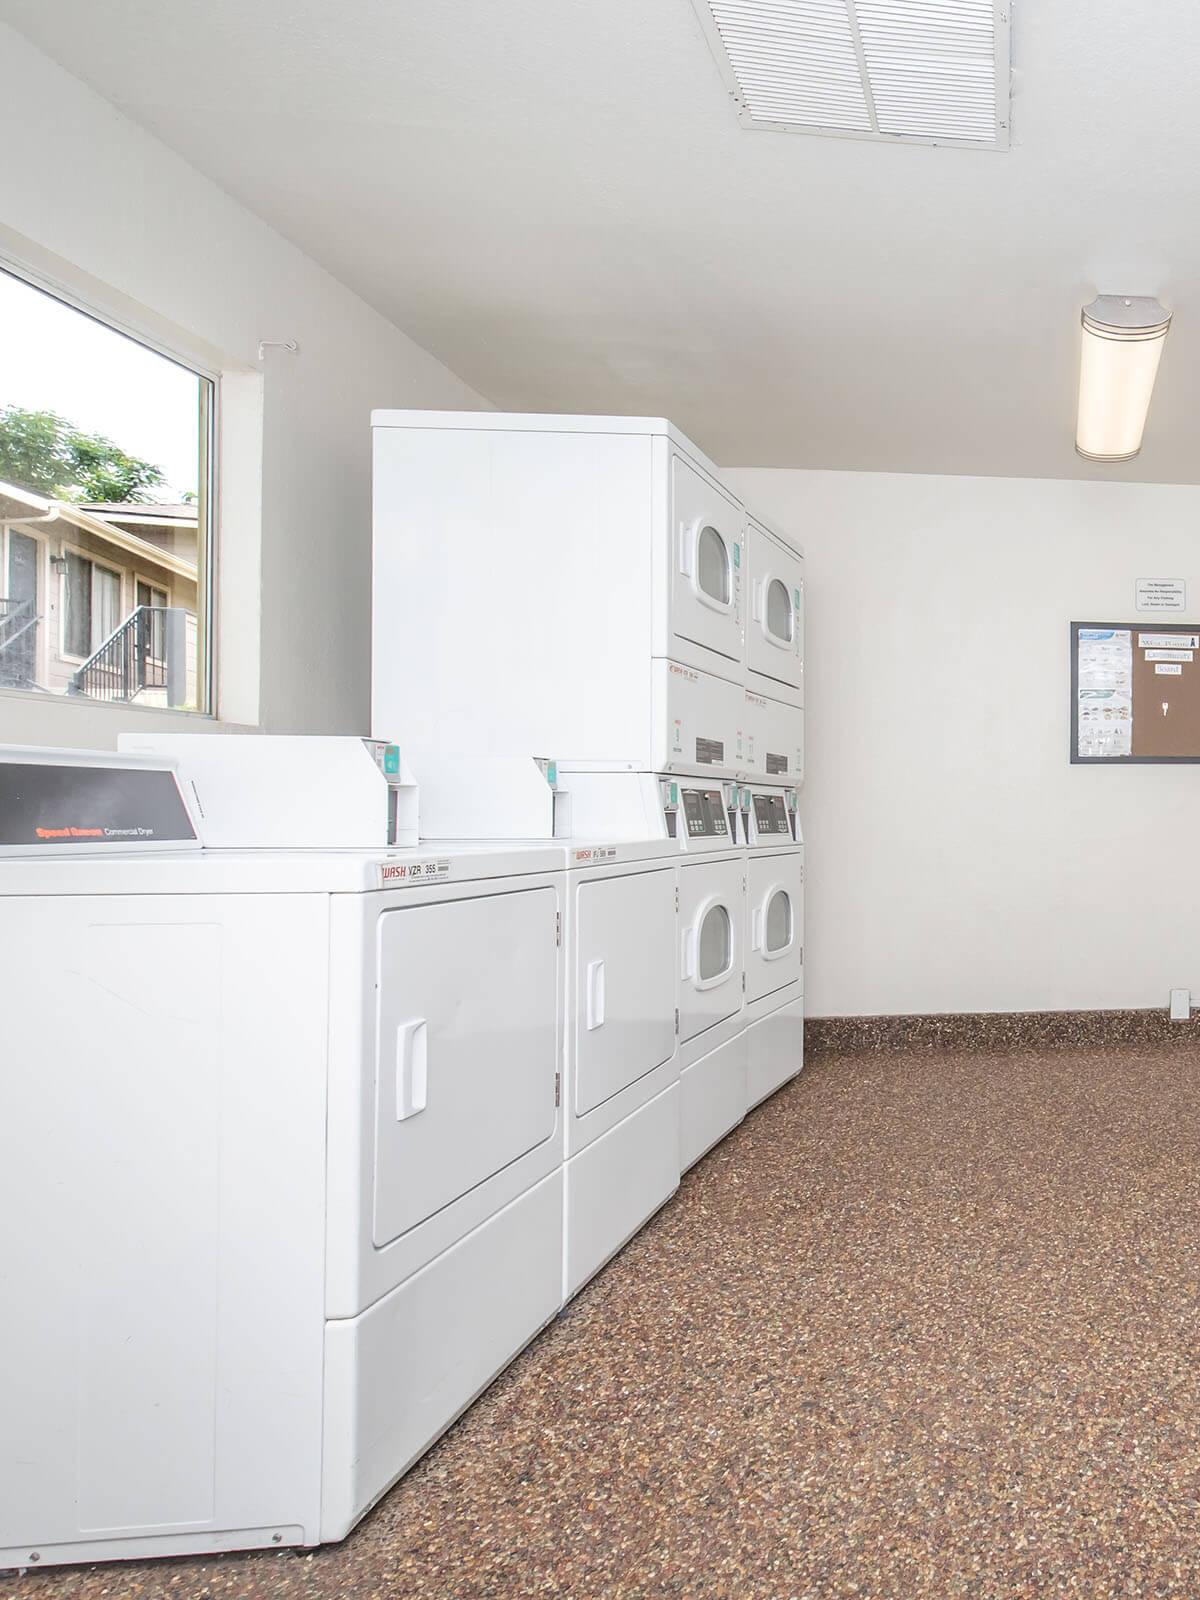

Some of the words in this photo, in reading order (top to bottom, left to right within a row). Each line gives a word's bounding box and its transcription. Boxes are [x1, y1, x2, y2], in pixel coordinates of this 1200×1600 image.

[104, 827, 138, 837] Commercial
[383, 866, 407, 879] WASH
[425, 863, 437, 875] 355
